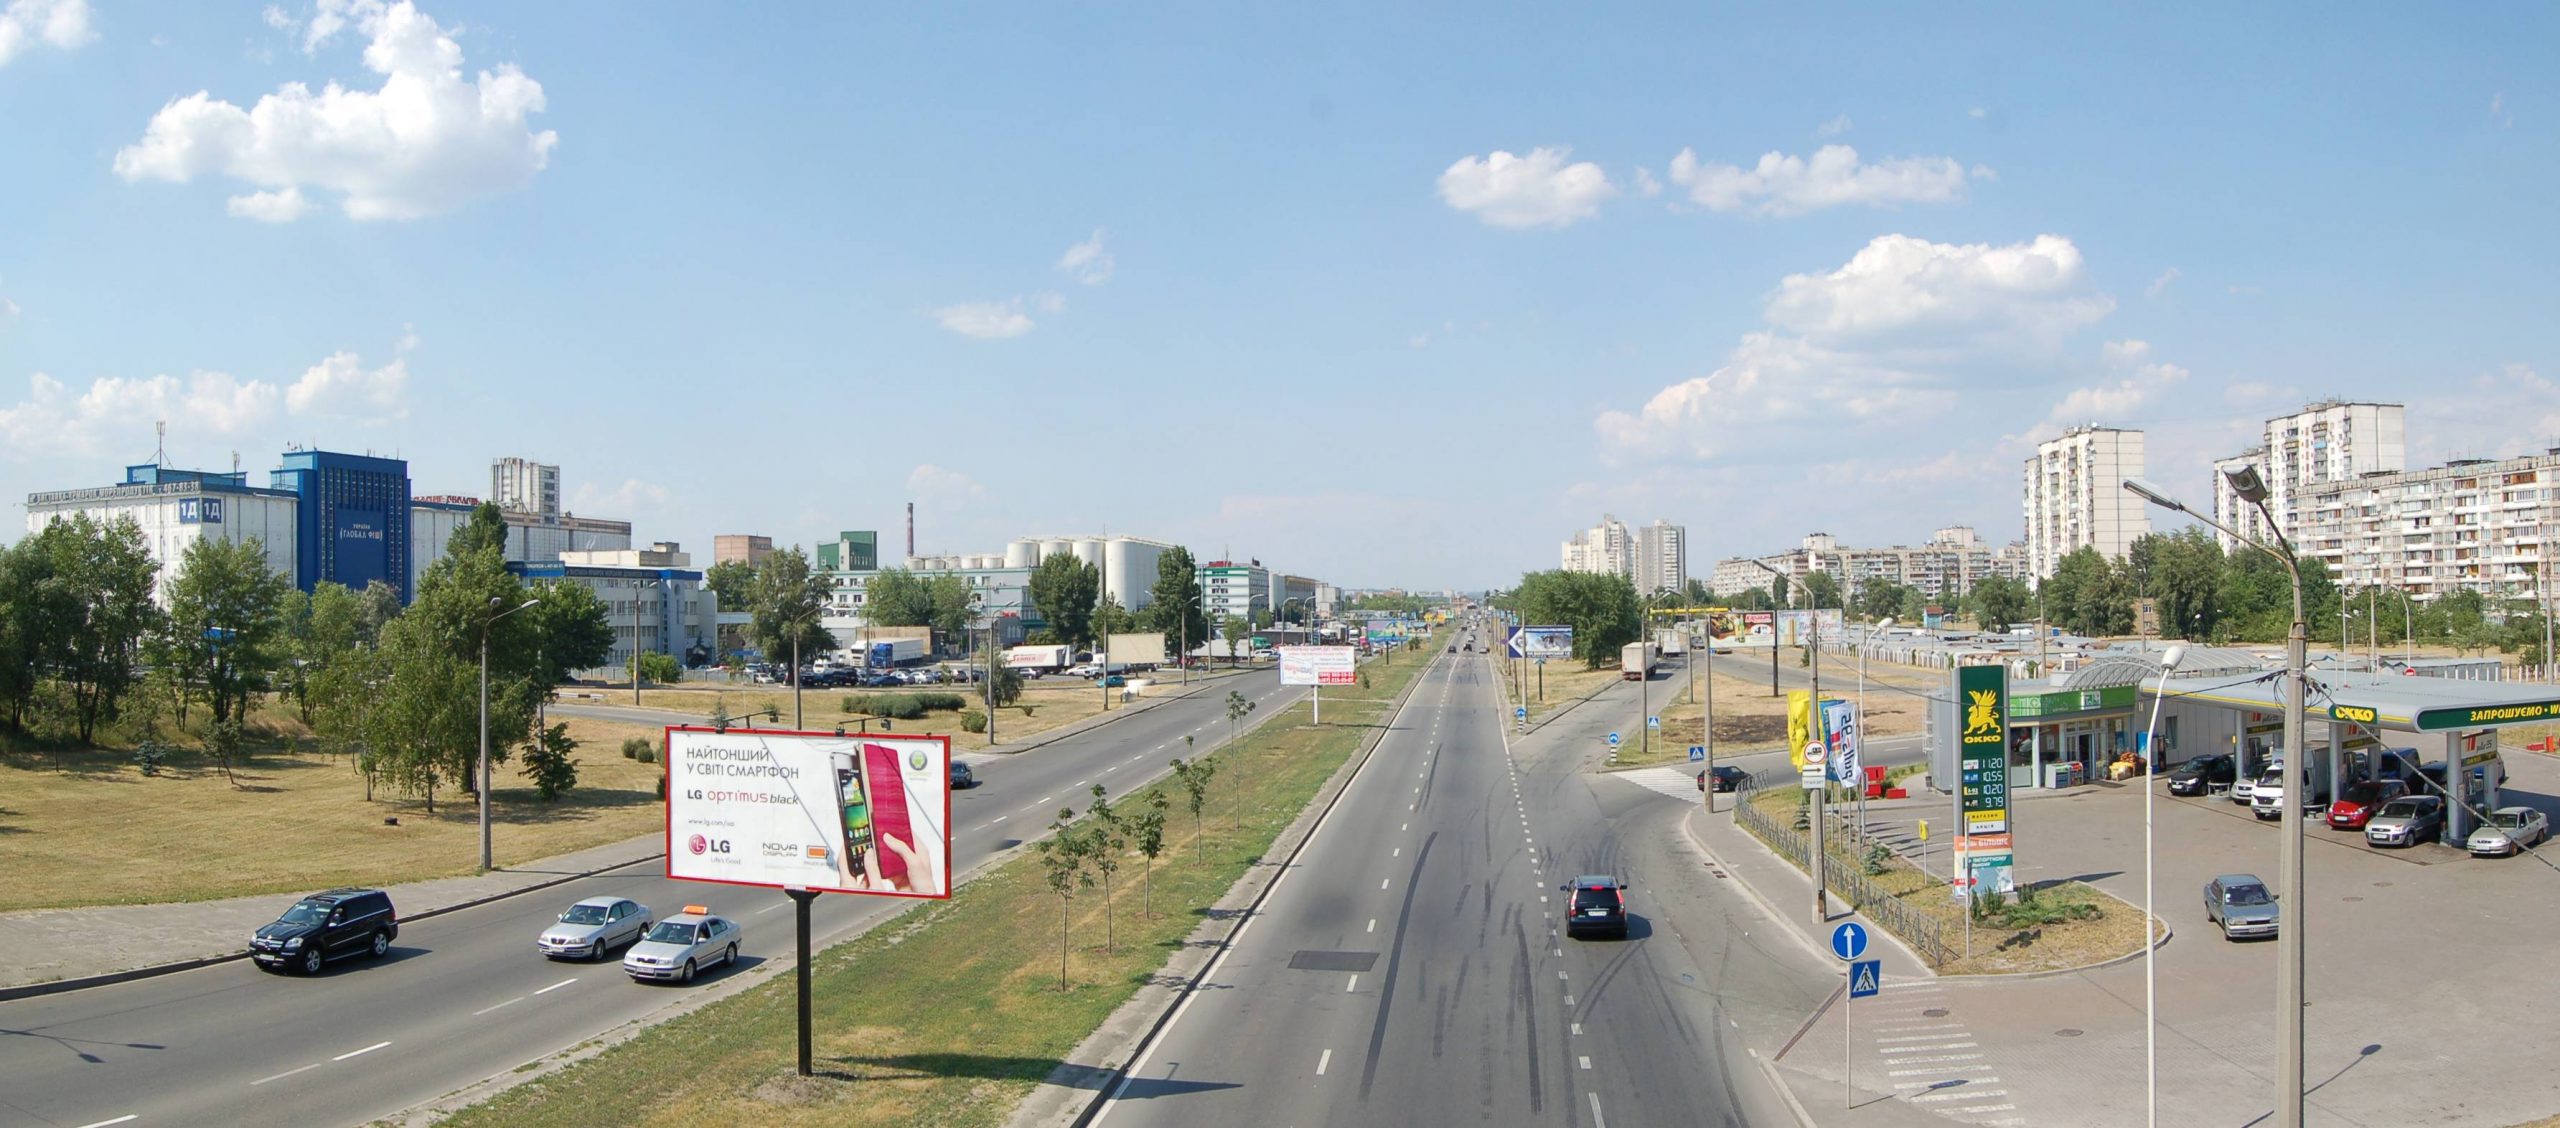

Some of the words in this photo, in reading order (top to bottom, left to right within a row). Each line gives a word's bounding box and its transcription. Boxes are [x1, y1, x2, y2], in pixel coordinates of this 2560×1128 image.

[181, 503, 197, 518] 1Д
[204, 503, 220, 519] 1Д
[2335, 707, 2374, 721] OKKO
[2470, 706, 2542, 721] ЗАПРОШУЄМО
[2550, 704, 2560, 715] W
[1964, 735, 2001, 743] OKKO
[687, 746, 770, 761] НАЙТОНШИЙ
[1982, 758, 2003, 769] 11.20
[687, 763, 694, 775] У
[697, 763, 724, 776] СВІТІ
[727, 765, 799, 779] СМАРТФОН
[1983, 771, 2003, 782] 10.55
[1983, 784, 2003, 795] 10.20
[688, 789, 702, 800] LG
[770, 794, 799, 805] black
[1985, 796, 2004, 807] 9.79
[711, 840, 730, 853] LG
[762, 843, 798, 851] NOVA
[726, 857, 741, 865] Good
